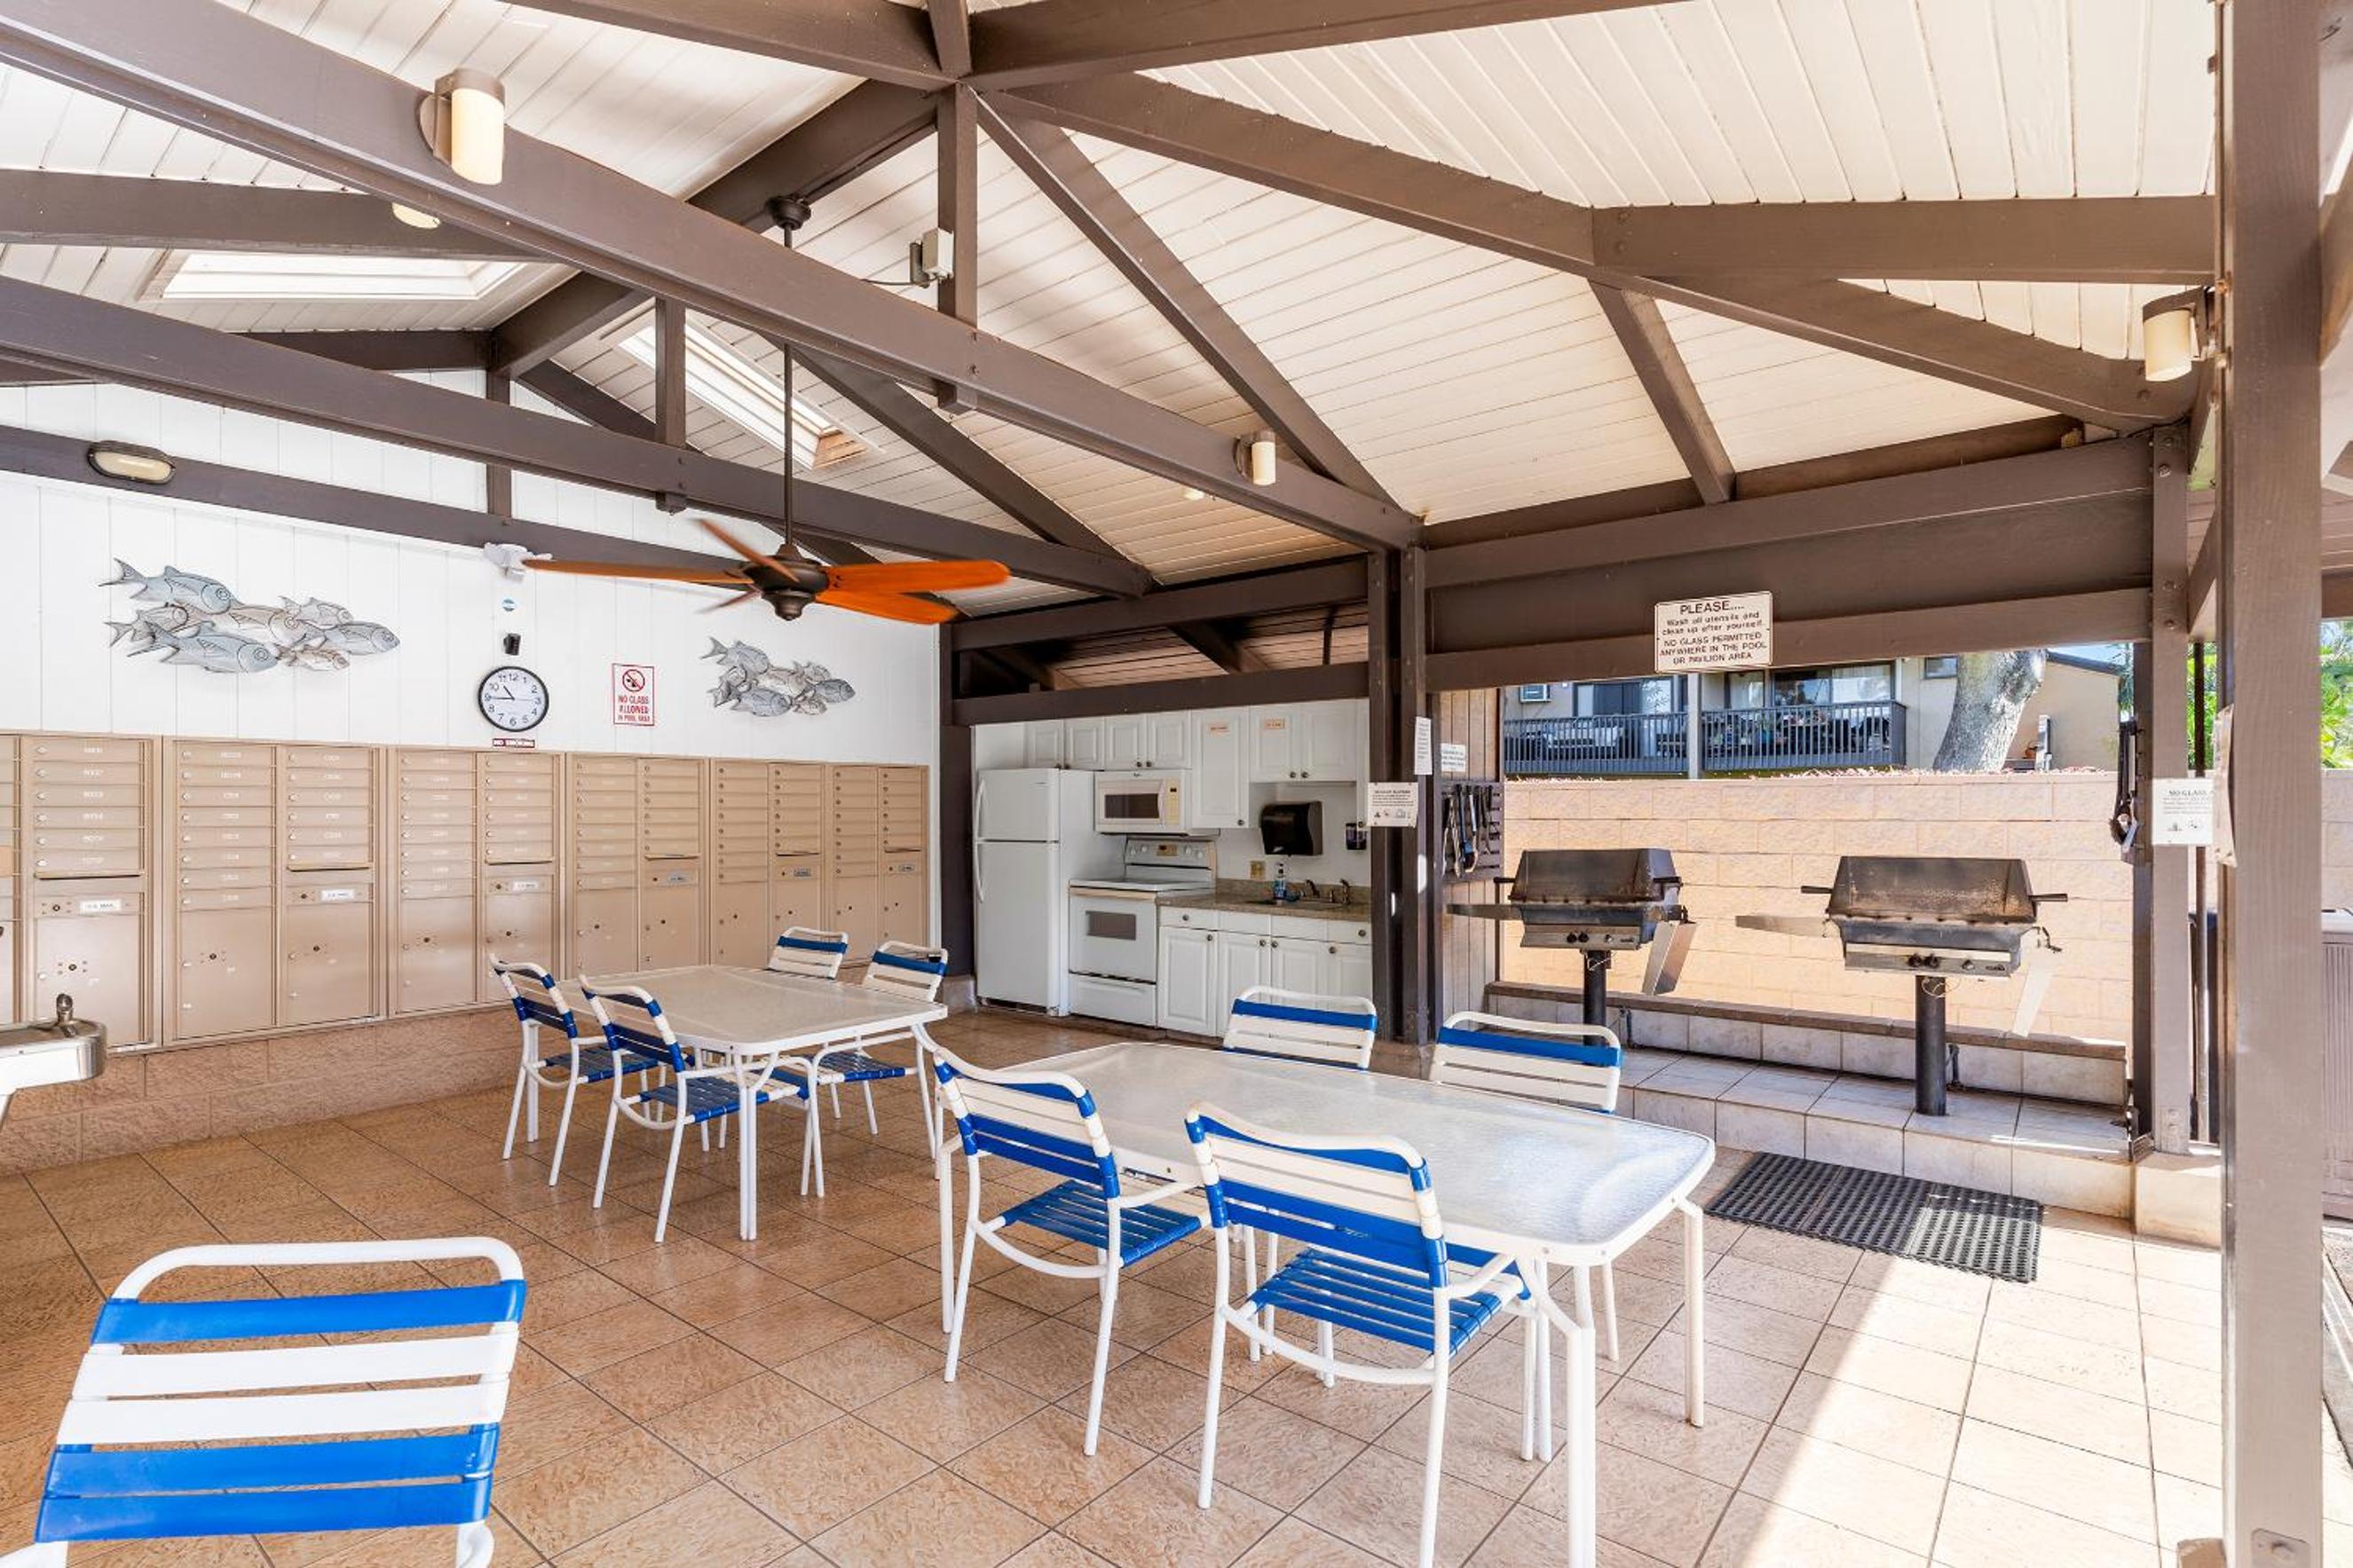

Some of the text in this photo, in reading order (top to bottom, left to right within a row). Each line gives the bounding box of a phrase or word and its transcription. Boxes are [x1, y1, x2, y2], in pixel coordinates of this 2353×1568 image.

[1680, 636, 1709, 645] GLASS
[1713, 631, 1762, 642] PERMITTED
[1660, 646, 1706, 656] ANYWHERE
[1742, 641, 1766, 650] POOL
[1728, 651, 1752, 660] AREA
[489, 682, 500, 691] 10
[532, 685, 537, 694] 2
[485, 693, 492, 702] 9
[629, 696, 649, 705] GLASS
[488, 704, 495, 713] 8
[531, 707, 537, 716] 4
[498, 713, 505, 721] 7
[522, 715, 529, 724] 5
[509, 717, 517, 727] 6
